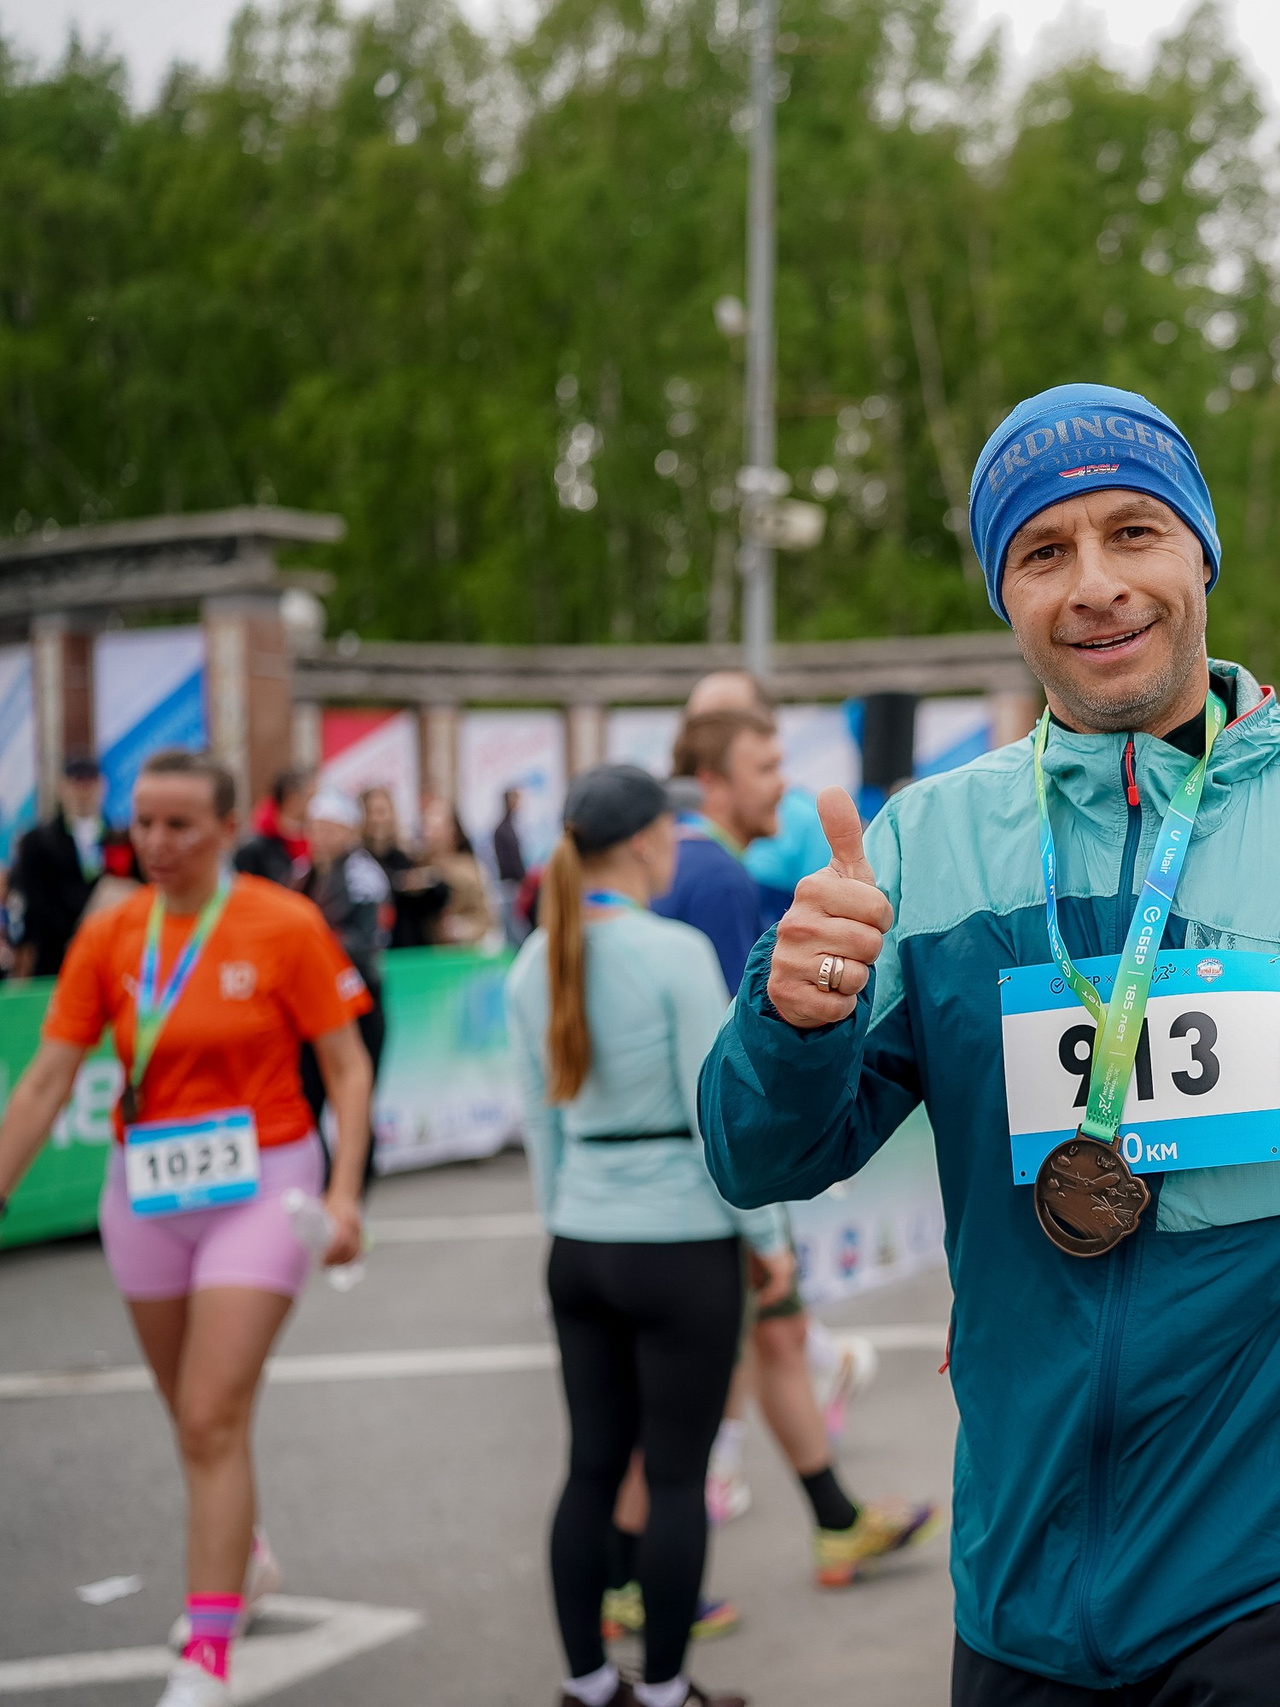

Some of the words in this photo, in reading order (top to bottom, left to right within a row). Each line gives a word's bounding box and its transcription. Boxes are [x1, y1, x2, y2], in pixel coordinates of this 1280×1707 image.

[987, 416, 1180, 494] ERDINGER
[1160, 848, 1177, 875] Utair
[1135, 926, 1153, 965] СБЕР
[1123, 984, 1137, 1010] 185
[1116, 1014, 1129, 1042] лет
[1058, 1011, 1221, 1108] 913
[146, 1142, 241, 1182] 1023
[1122, 1132, 1143, 1164] 0
